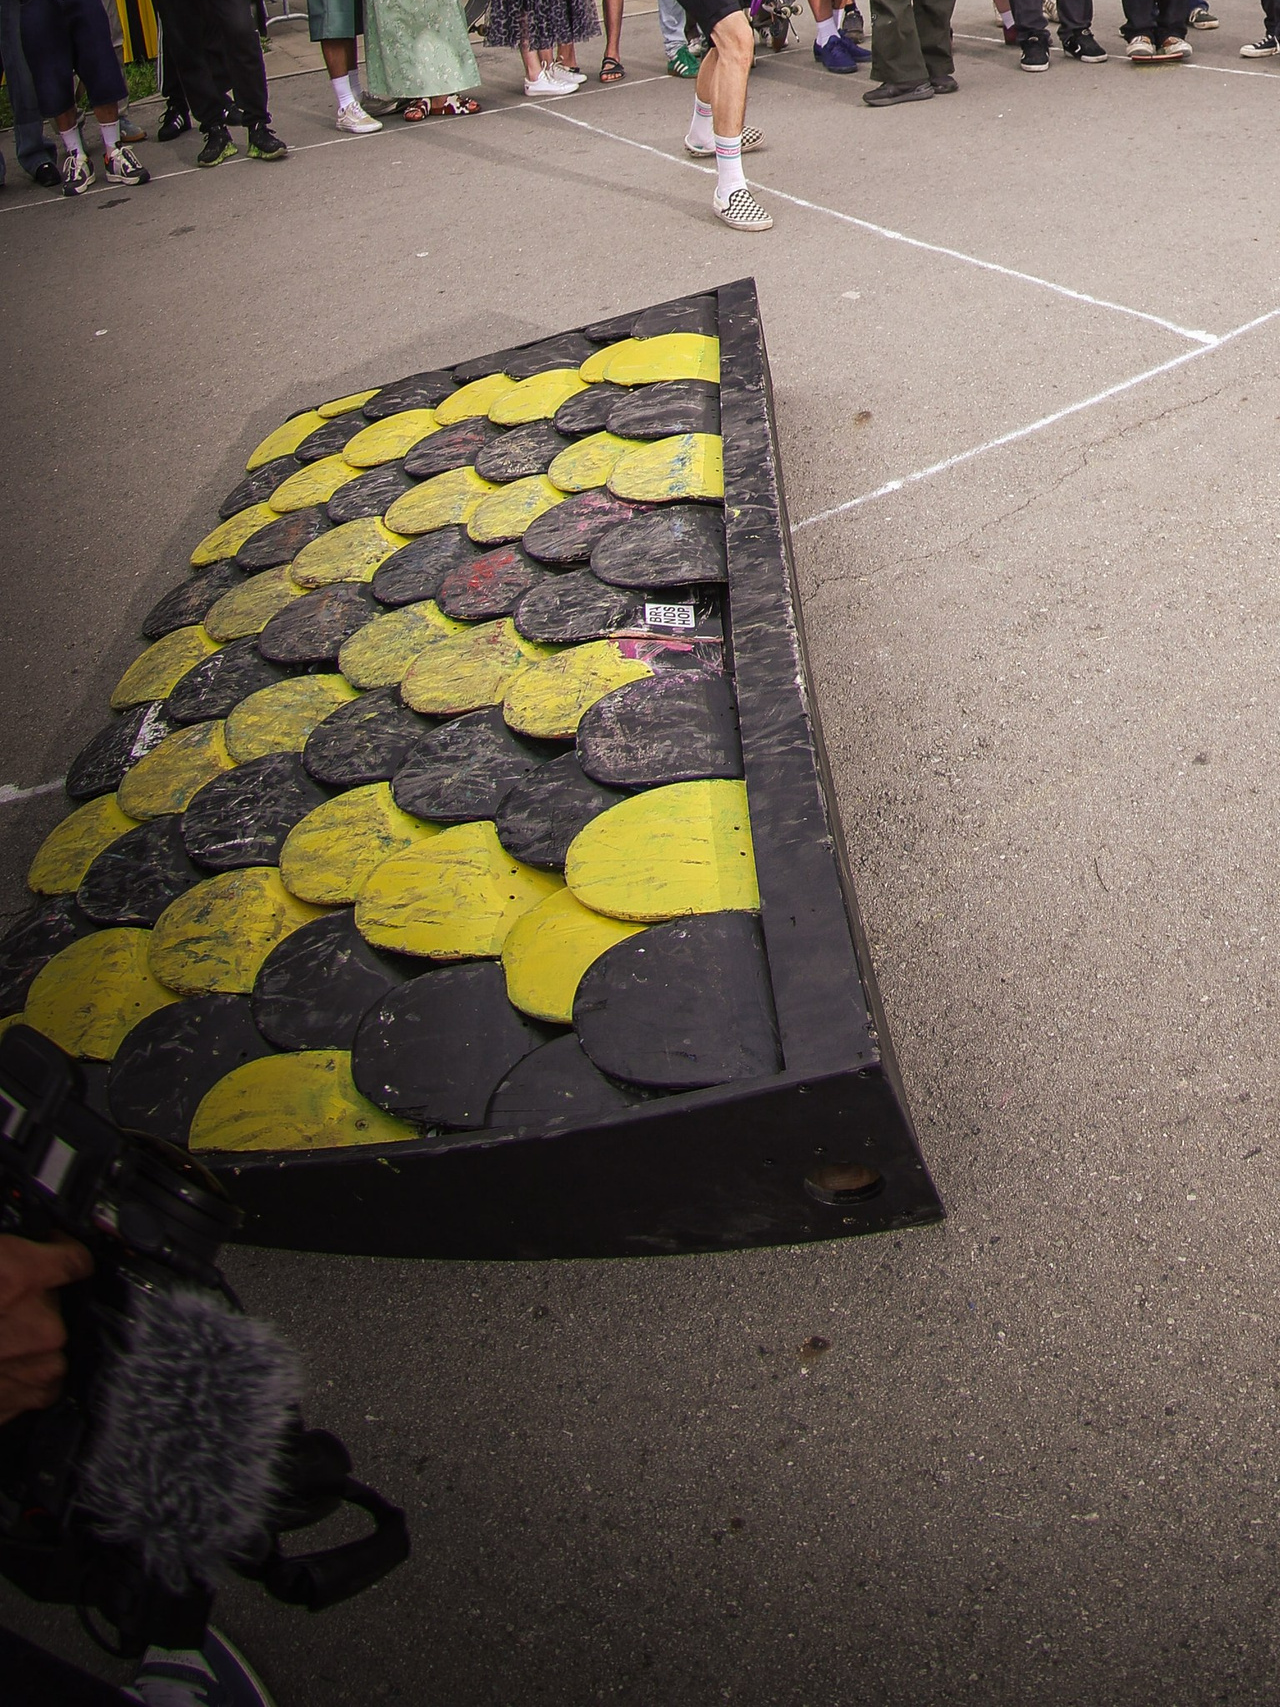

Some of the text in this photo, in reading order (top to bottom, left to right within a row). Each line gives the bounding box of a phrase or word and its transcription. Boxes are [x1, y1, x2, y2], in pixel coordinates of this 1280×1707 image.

[649, 606, 662, 623] BRA
[663, 606, 676, 625] NDS
[677, 607, 691, 626] HOP
